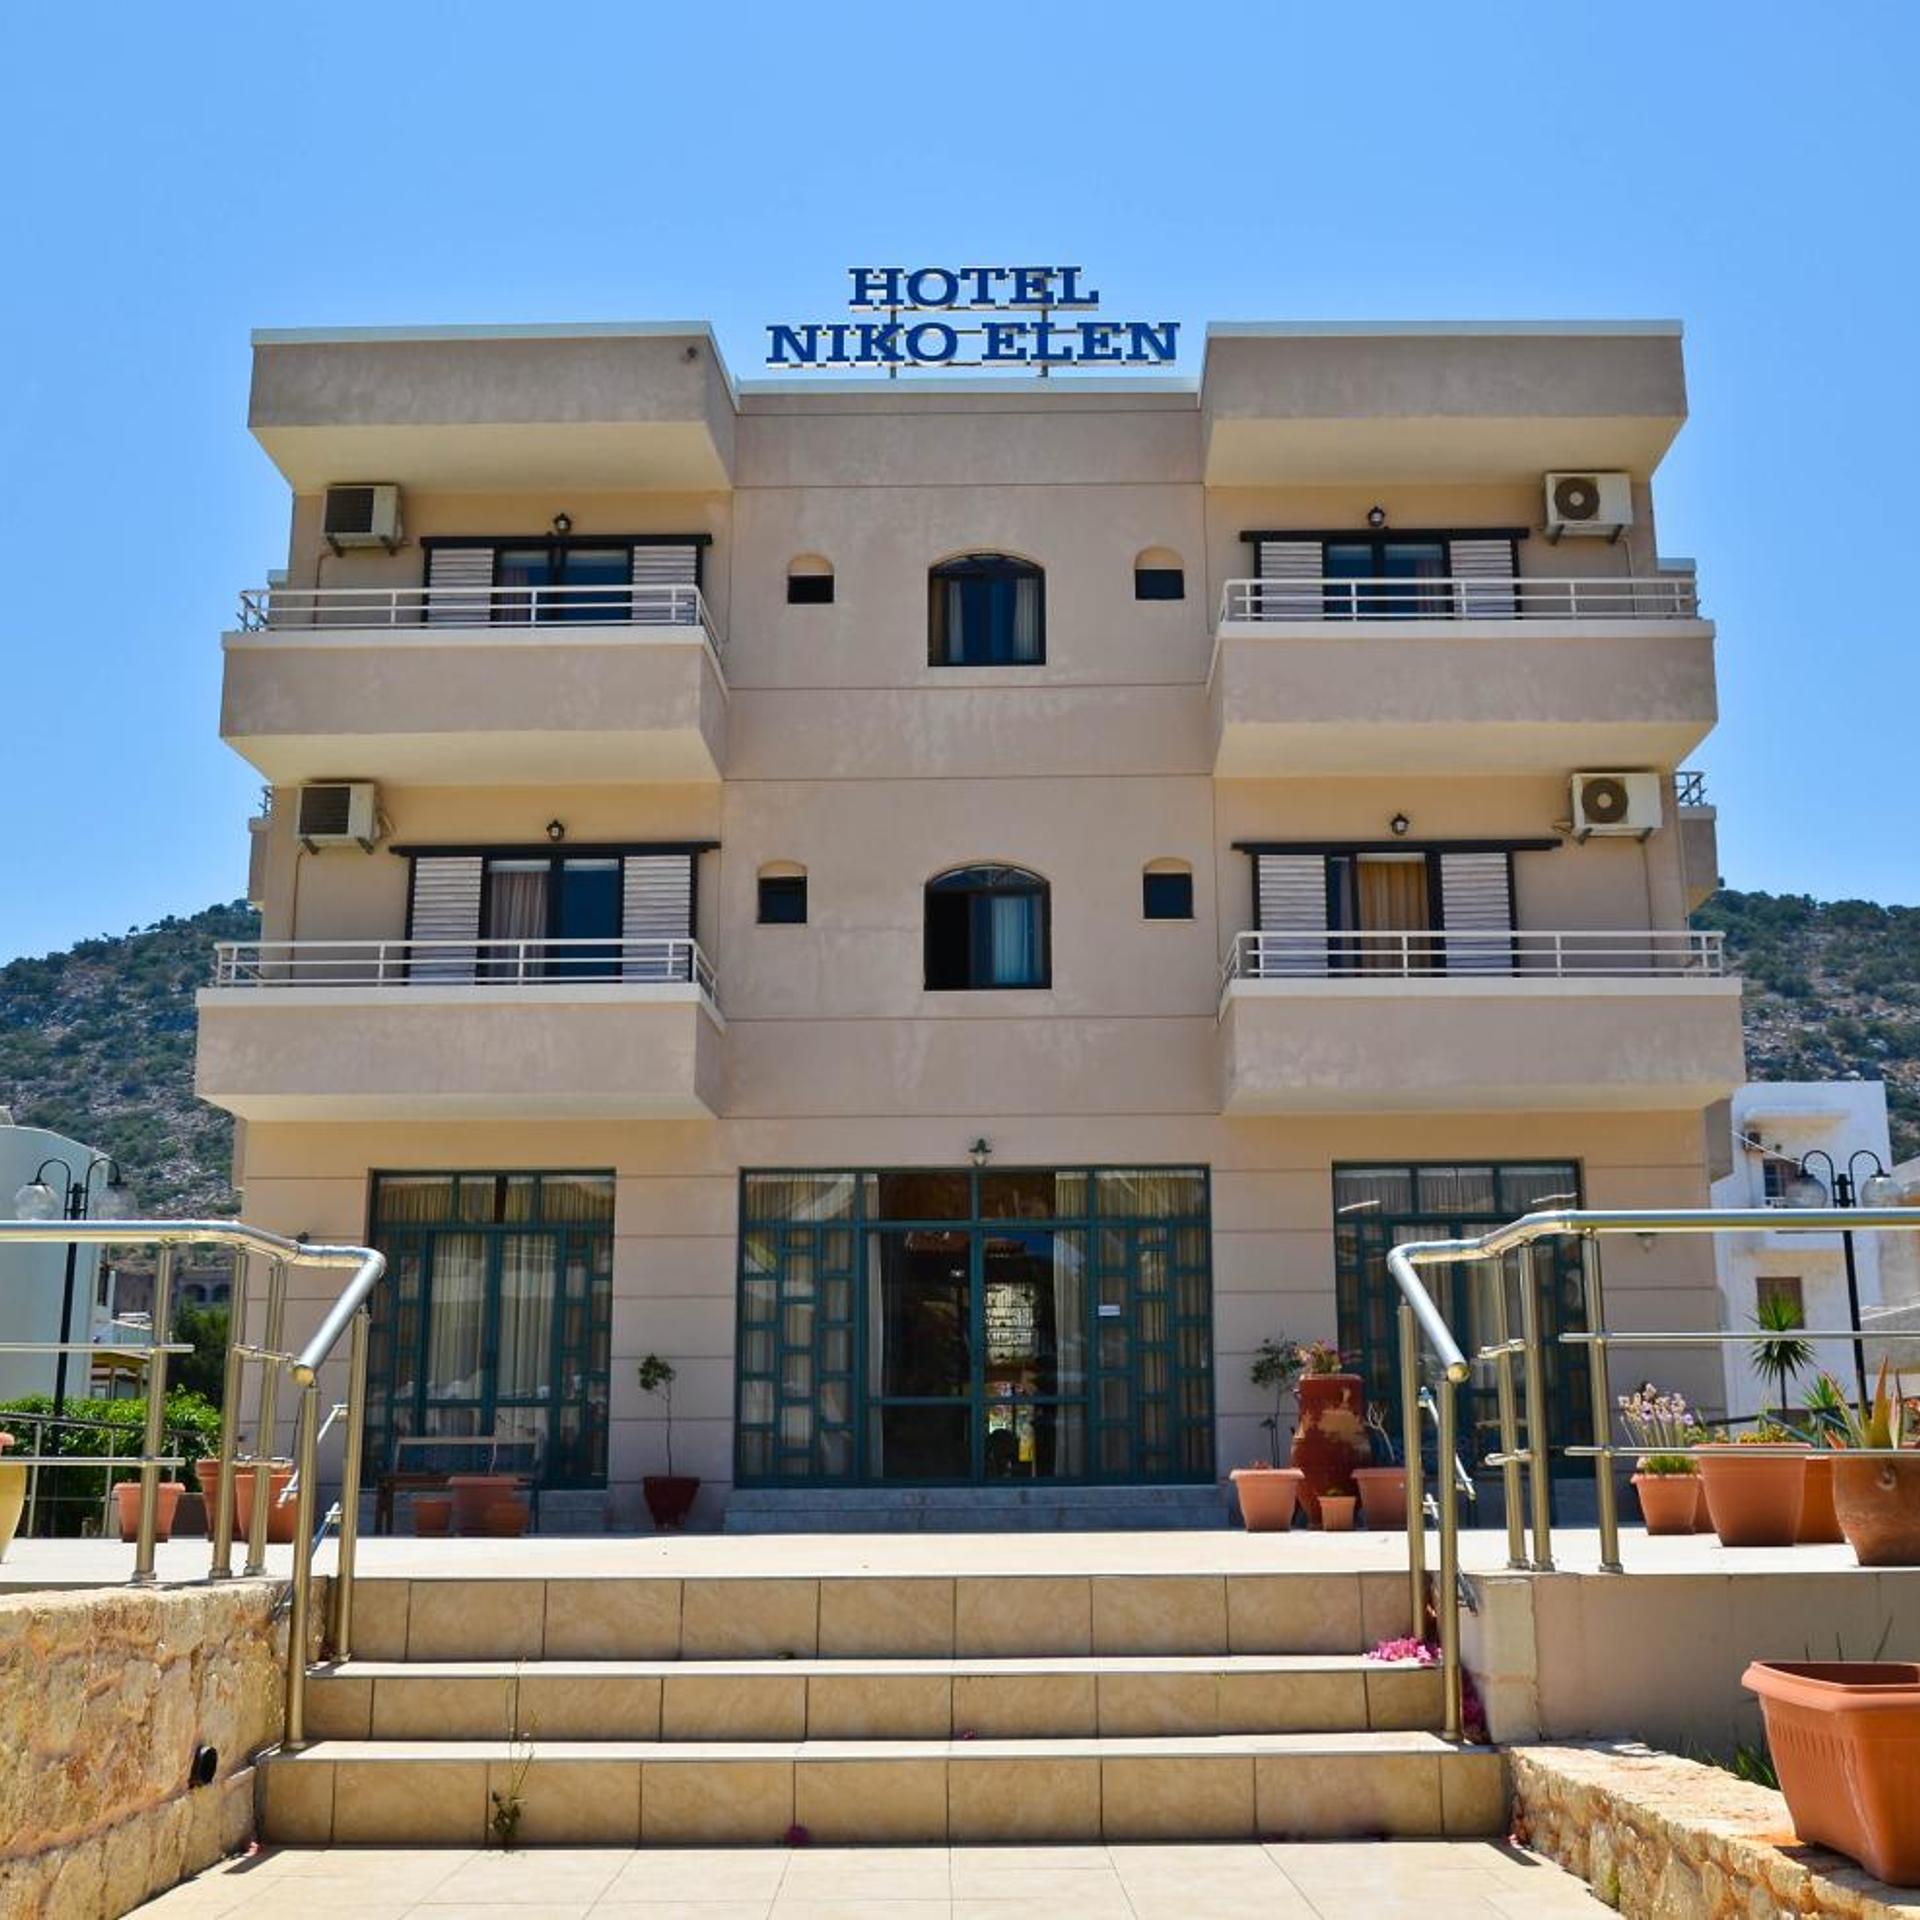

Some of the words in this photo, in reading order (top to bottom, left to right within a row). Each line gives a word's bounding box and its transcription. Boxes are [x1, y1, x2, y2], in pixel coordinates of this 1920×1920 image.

[848, 267, 1099, 308] HOTEL
[766, 323, 958, 364] NIKO
[981, 322, 1180, 363] ELEN
